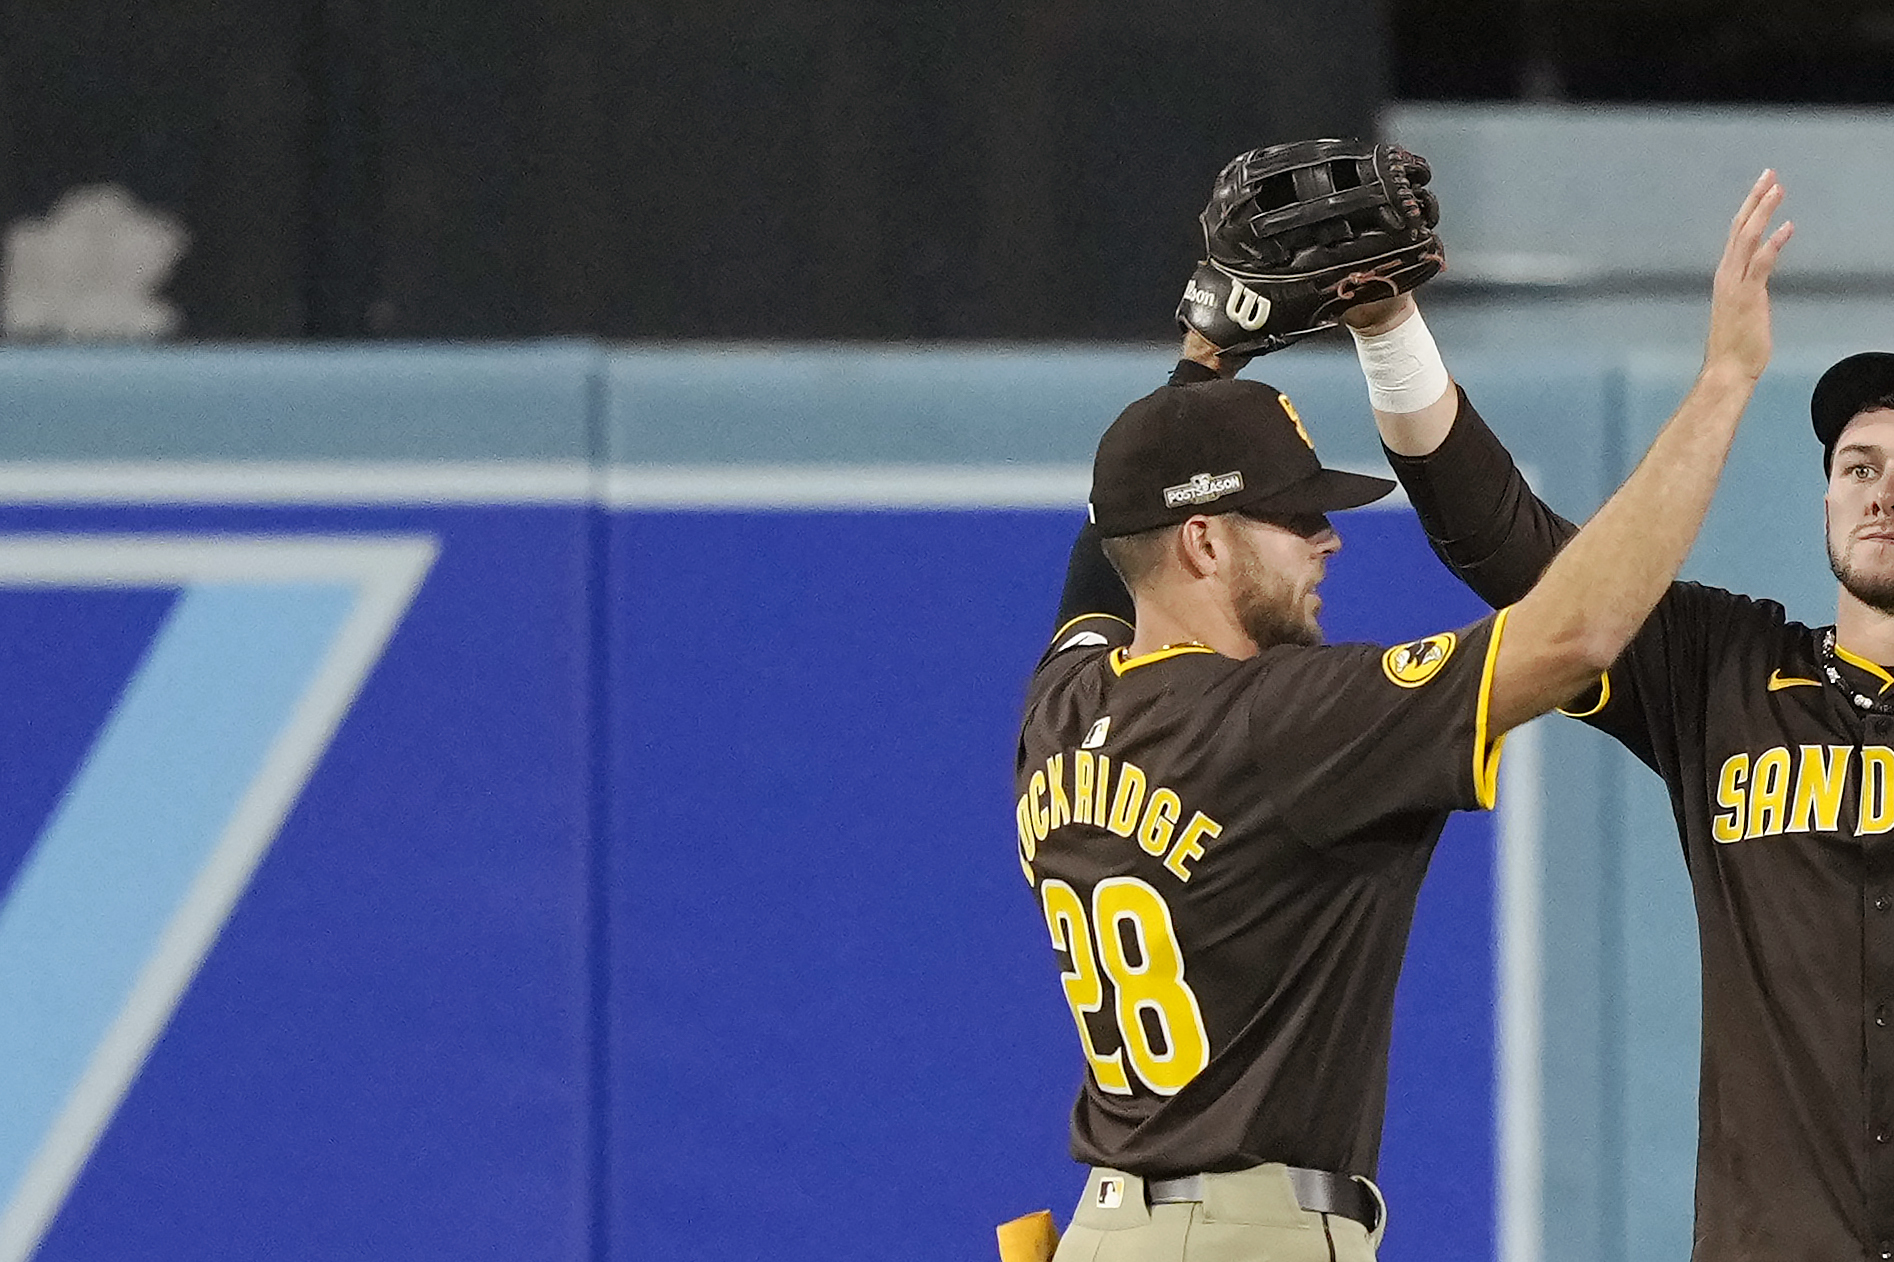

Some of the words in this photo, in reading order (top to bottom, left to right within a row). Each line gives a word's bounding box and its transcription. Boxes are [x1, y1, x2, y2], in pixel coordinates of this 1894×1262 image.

[1226, 278, 1271, 331] W
[1168, 475, 1240, 504] POSTSEASON
[1712, 743, 1854, 844] SAN
[1041, 876, 1211, 1097] 28
